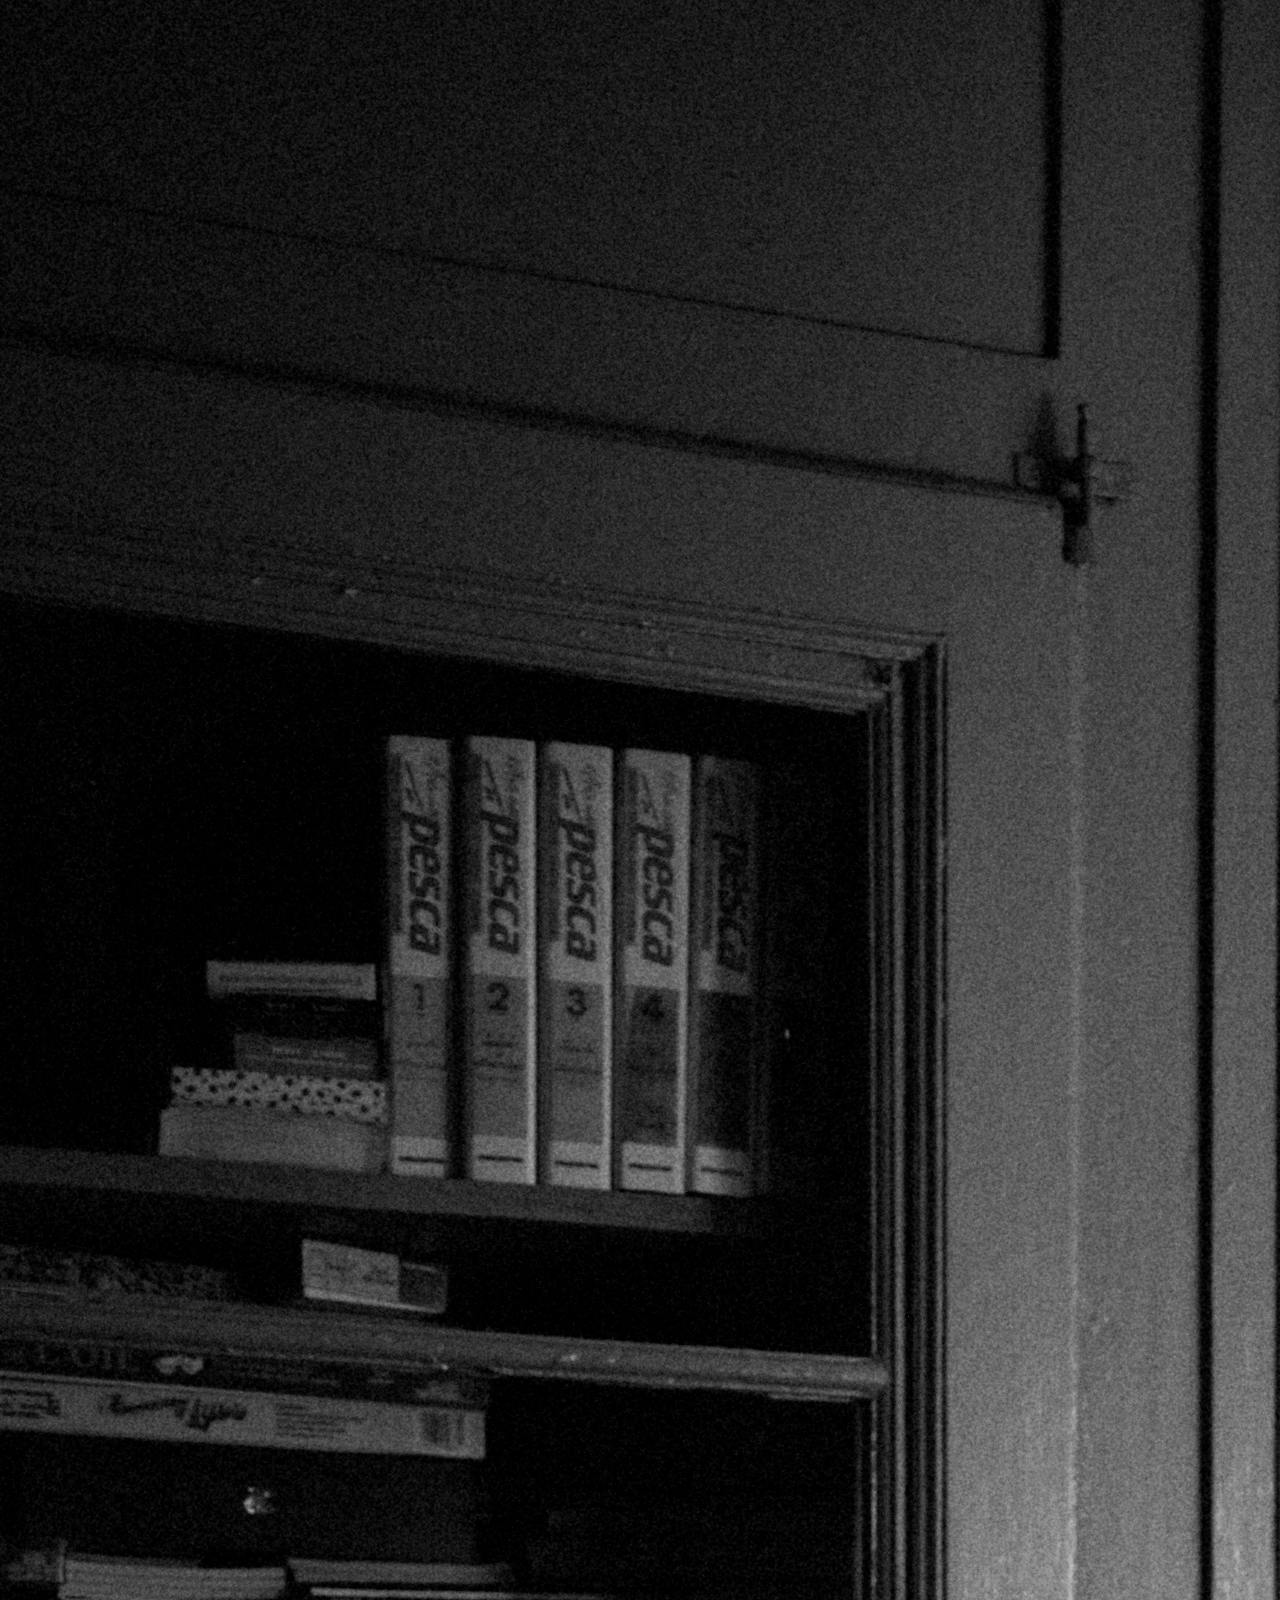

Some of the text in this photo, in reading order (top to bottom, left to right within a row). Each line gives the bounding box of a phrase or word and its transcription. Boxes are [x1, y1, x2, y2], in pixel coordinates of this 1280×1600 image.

[402, 812, 442, 955] pesca
[480, 812, 521, 954] pesca
[560, 818, 598, 961] pesca
[637, 824, 676, 966] pesca
[714, 833, 750, 973] pesca
[414, 985, 425, 1011] 1
[487, 982, 509, 1012] 2
[567, 989, 587, 1017] 3
[641, 995, 664, 1020] 4
